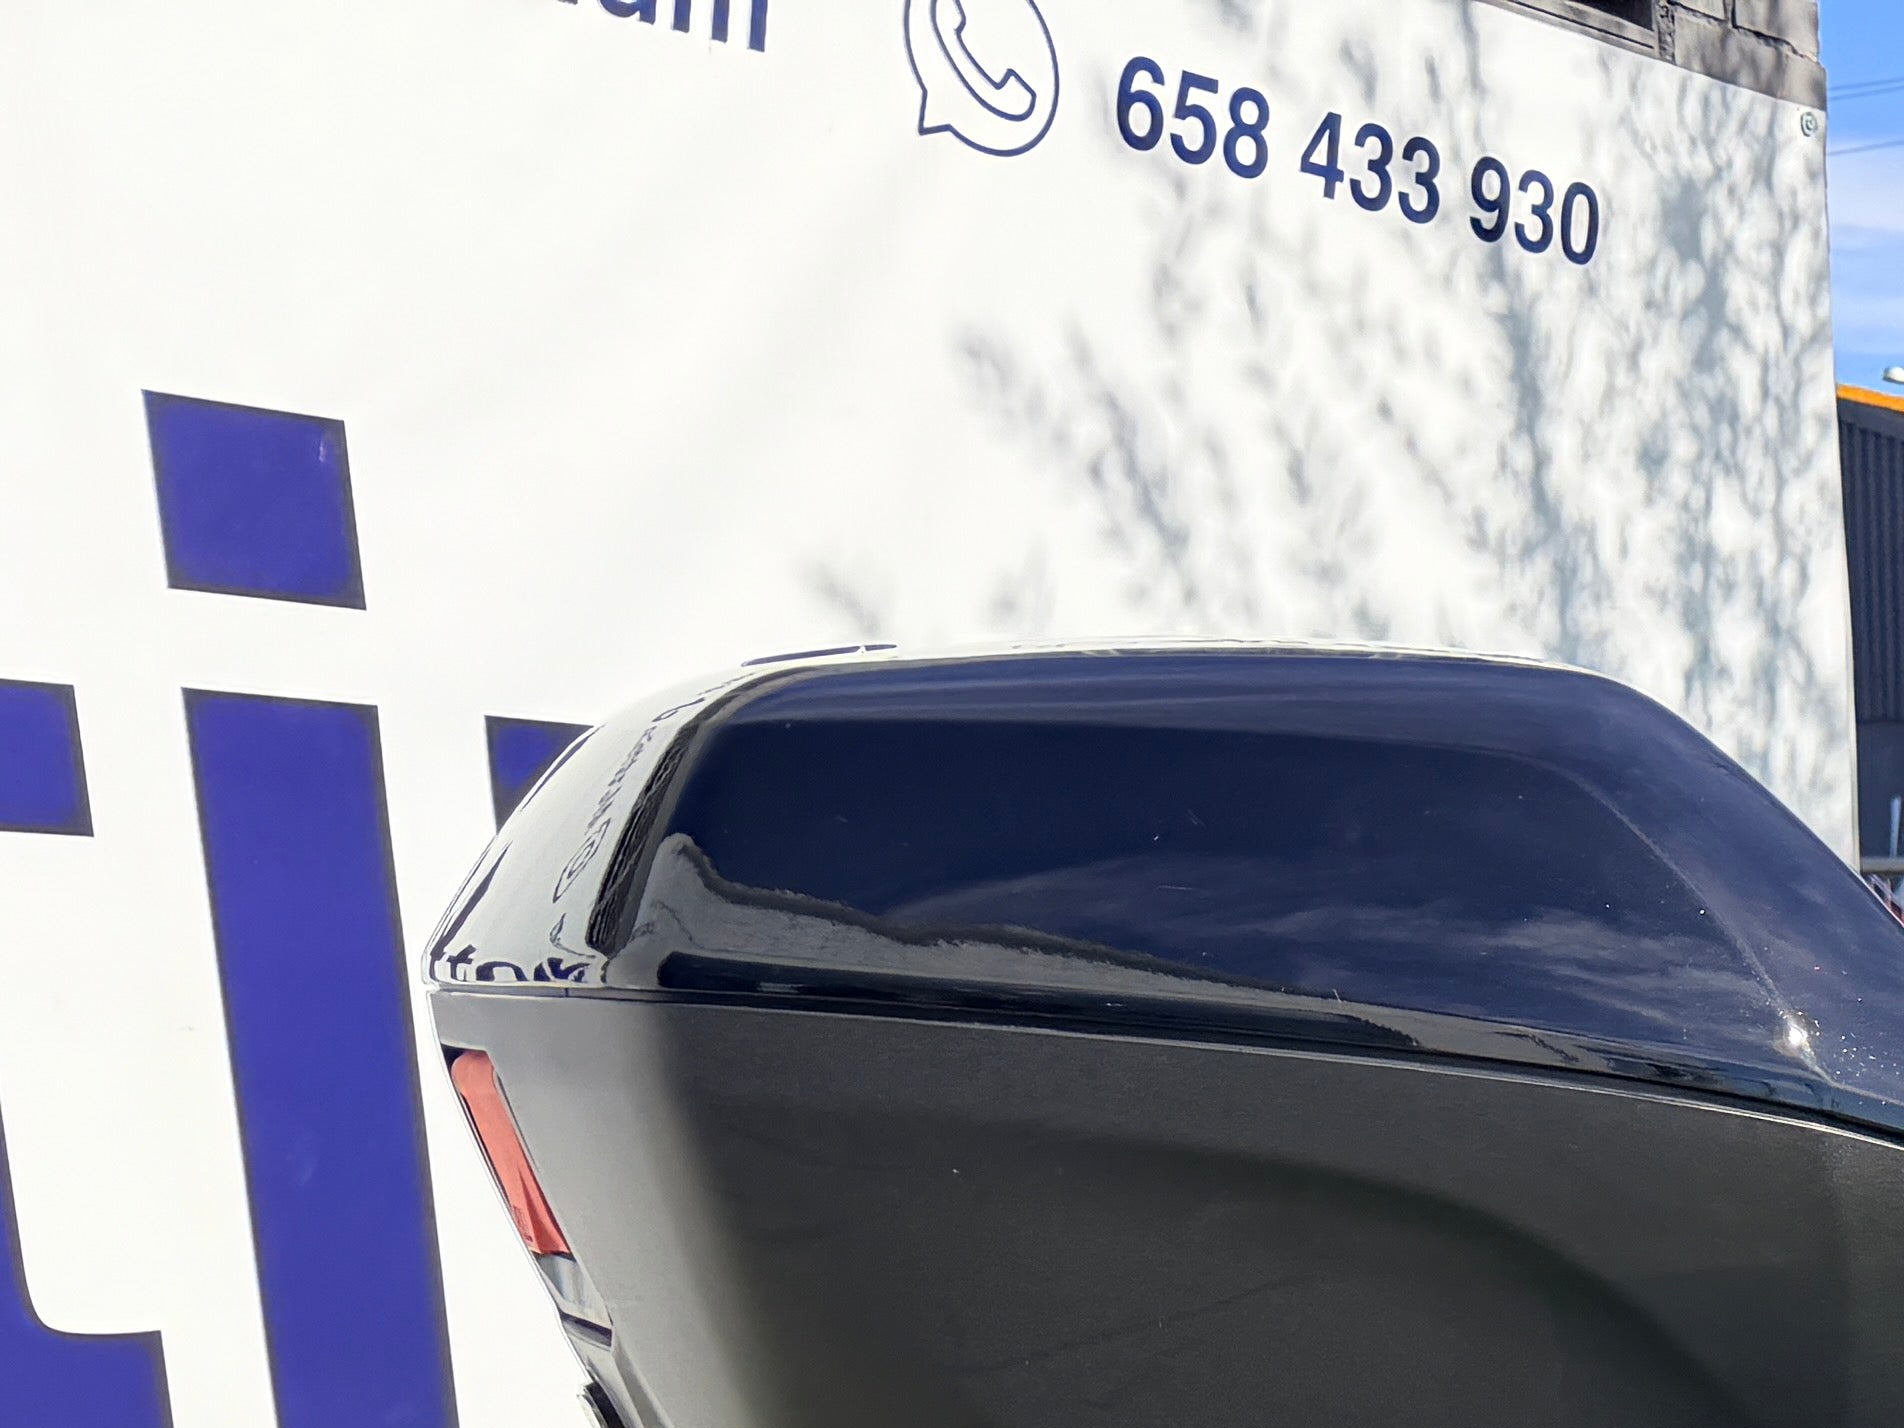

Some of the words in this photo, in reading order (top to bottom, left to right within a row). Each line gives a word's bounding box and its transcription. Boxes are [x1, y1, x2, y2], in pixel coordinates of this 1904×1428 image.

[1116, 55, 1270, 179] 658
[1299, 110, 1441, 224] 433
[1469, 155, 1600, 265] 930
